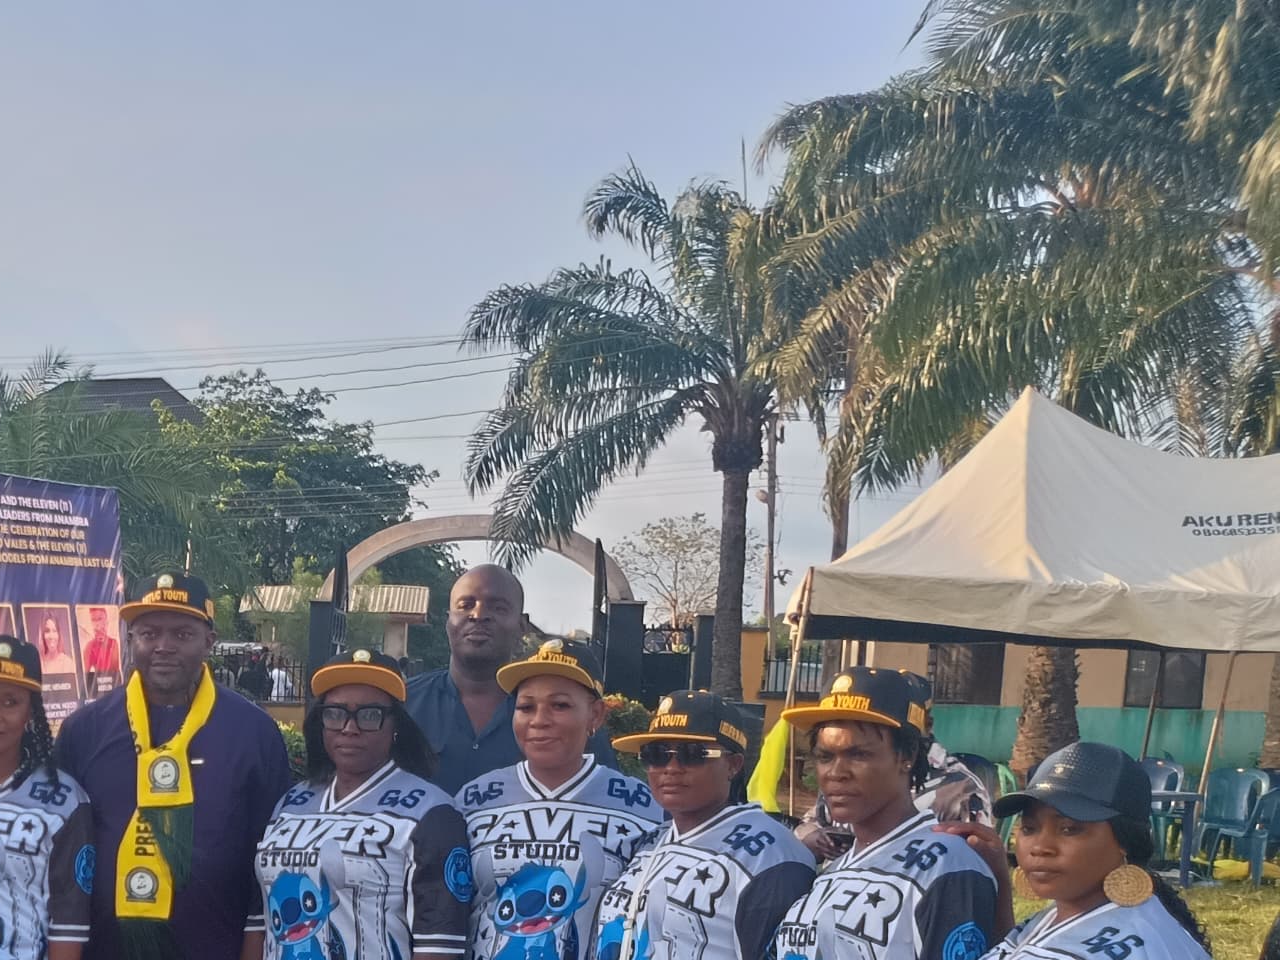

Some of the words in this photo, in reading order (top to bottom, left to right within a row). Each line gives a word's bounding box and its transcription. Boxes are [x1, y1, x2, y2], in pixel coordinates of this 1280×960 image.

[0, 494, 18, 506] AND
[17, 496, 32, 508] THE
[32, 498, 59, 511] ELEVEN
[0, 508, 31, 522] LEADERS
[31, 511, 53, 524] FROM
[53, 514, 89, 527] ANAMBRA
[1181, 515, 1233, 527] AKU
[10, 524, 59, 538] CELEBRATION
[59, 528, 70, 538] OF
[29, 540, 36, 551] &
[36, 540, 51, 551] THE
[51, 541, 75, 553] ELEVEN
[26, 553, 49, 565] FROM
[83, 557, 100, 568] EAST
[162, 589, 188, 603] YOUTH
[547, 651, 578, 666] YOUTH
[836, 694, 871, 711] YOUTH
[659, 713, 688, 728] YOUTH
[259, 817, 395, 859] AVER
[467, 806, 644, 862] GAVER
[260, 849, 320, 868] STUDIO
[493, 842, 581, 862] STUDIO
